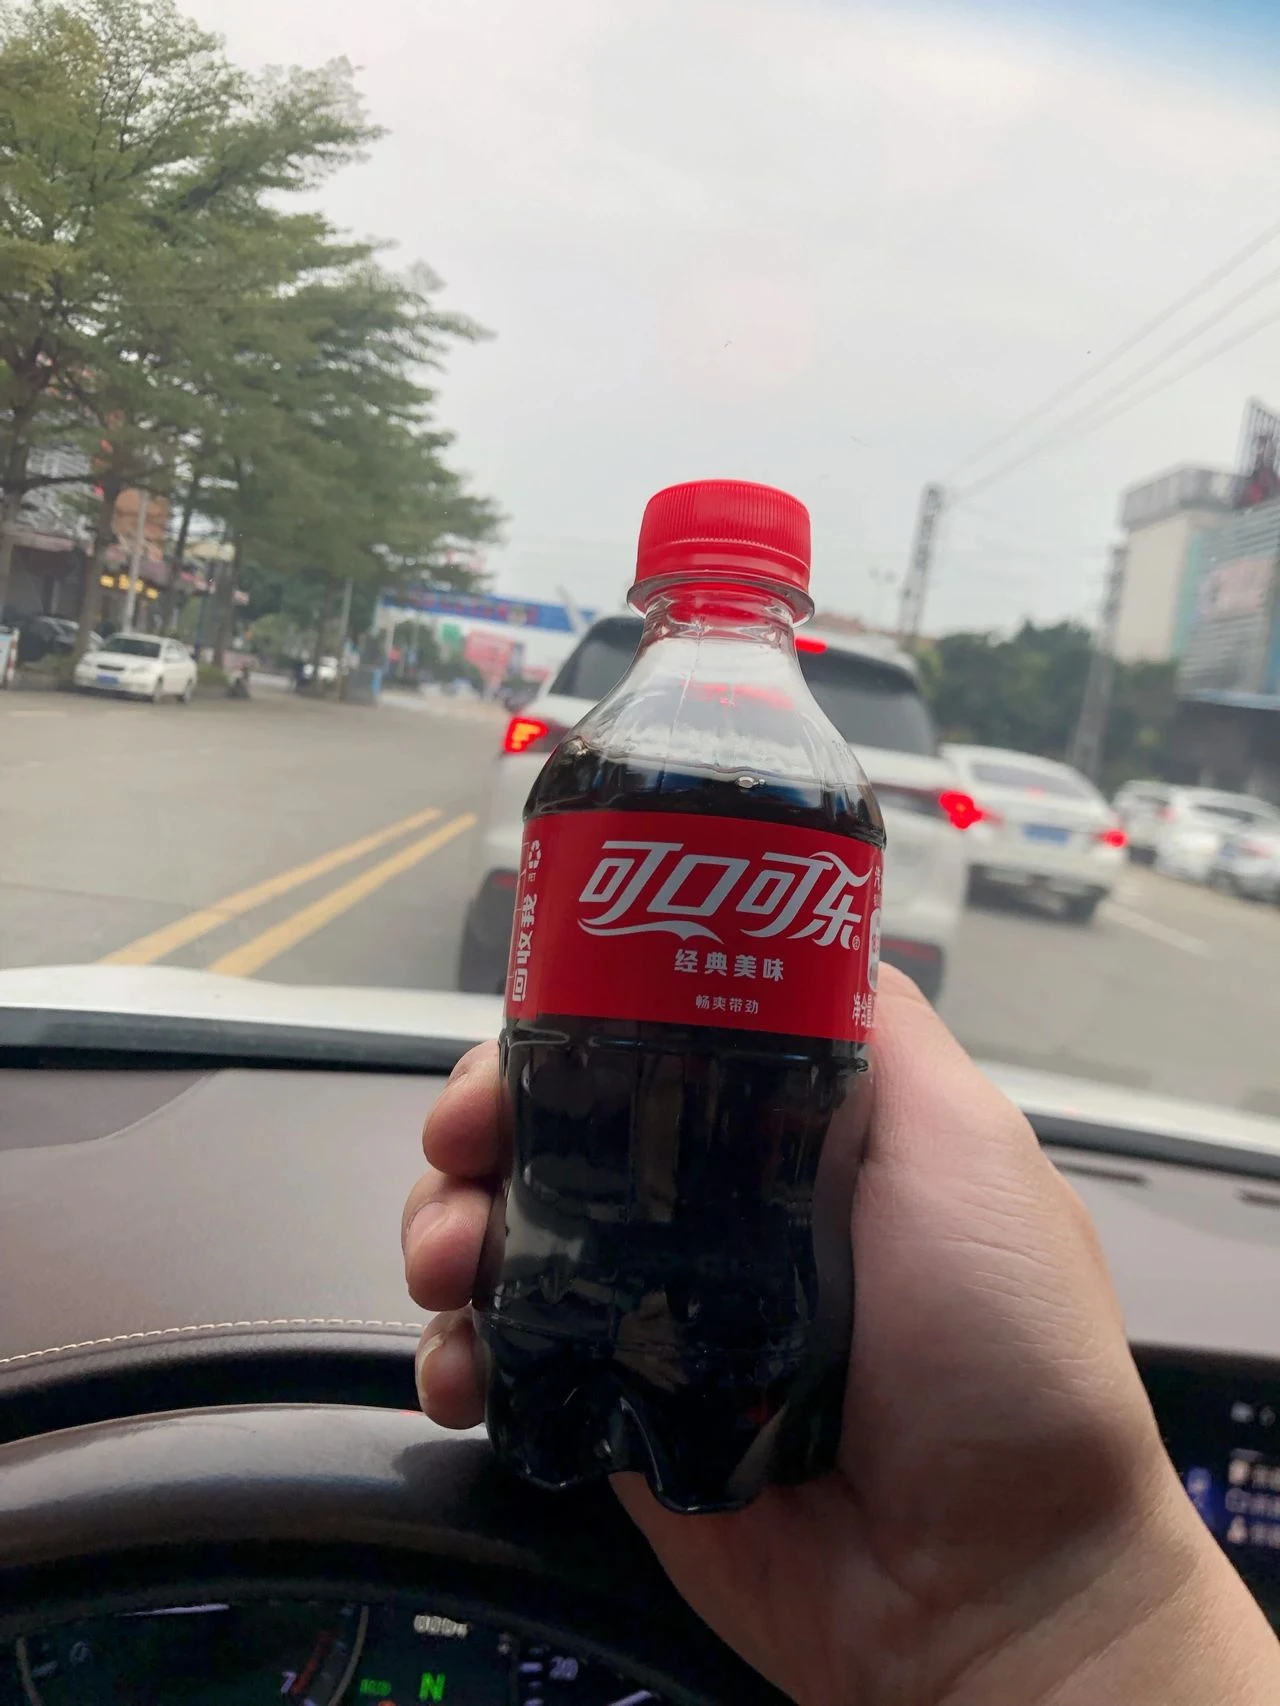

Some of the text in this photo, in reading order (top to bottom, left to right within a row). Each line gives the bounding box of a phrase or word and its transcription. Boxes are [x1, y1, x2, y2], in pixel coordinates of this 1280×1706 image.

[577, 840, 872, 950] 可口可乐
[674, 949, 784, 982] 经典美味
[695, 994, 760, 1014] 畅爽带劲
[419, 1672, 446, 1703] N
